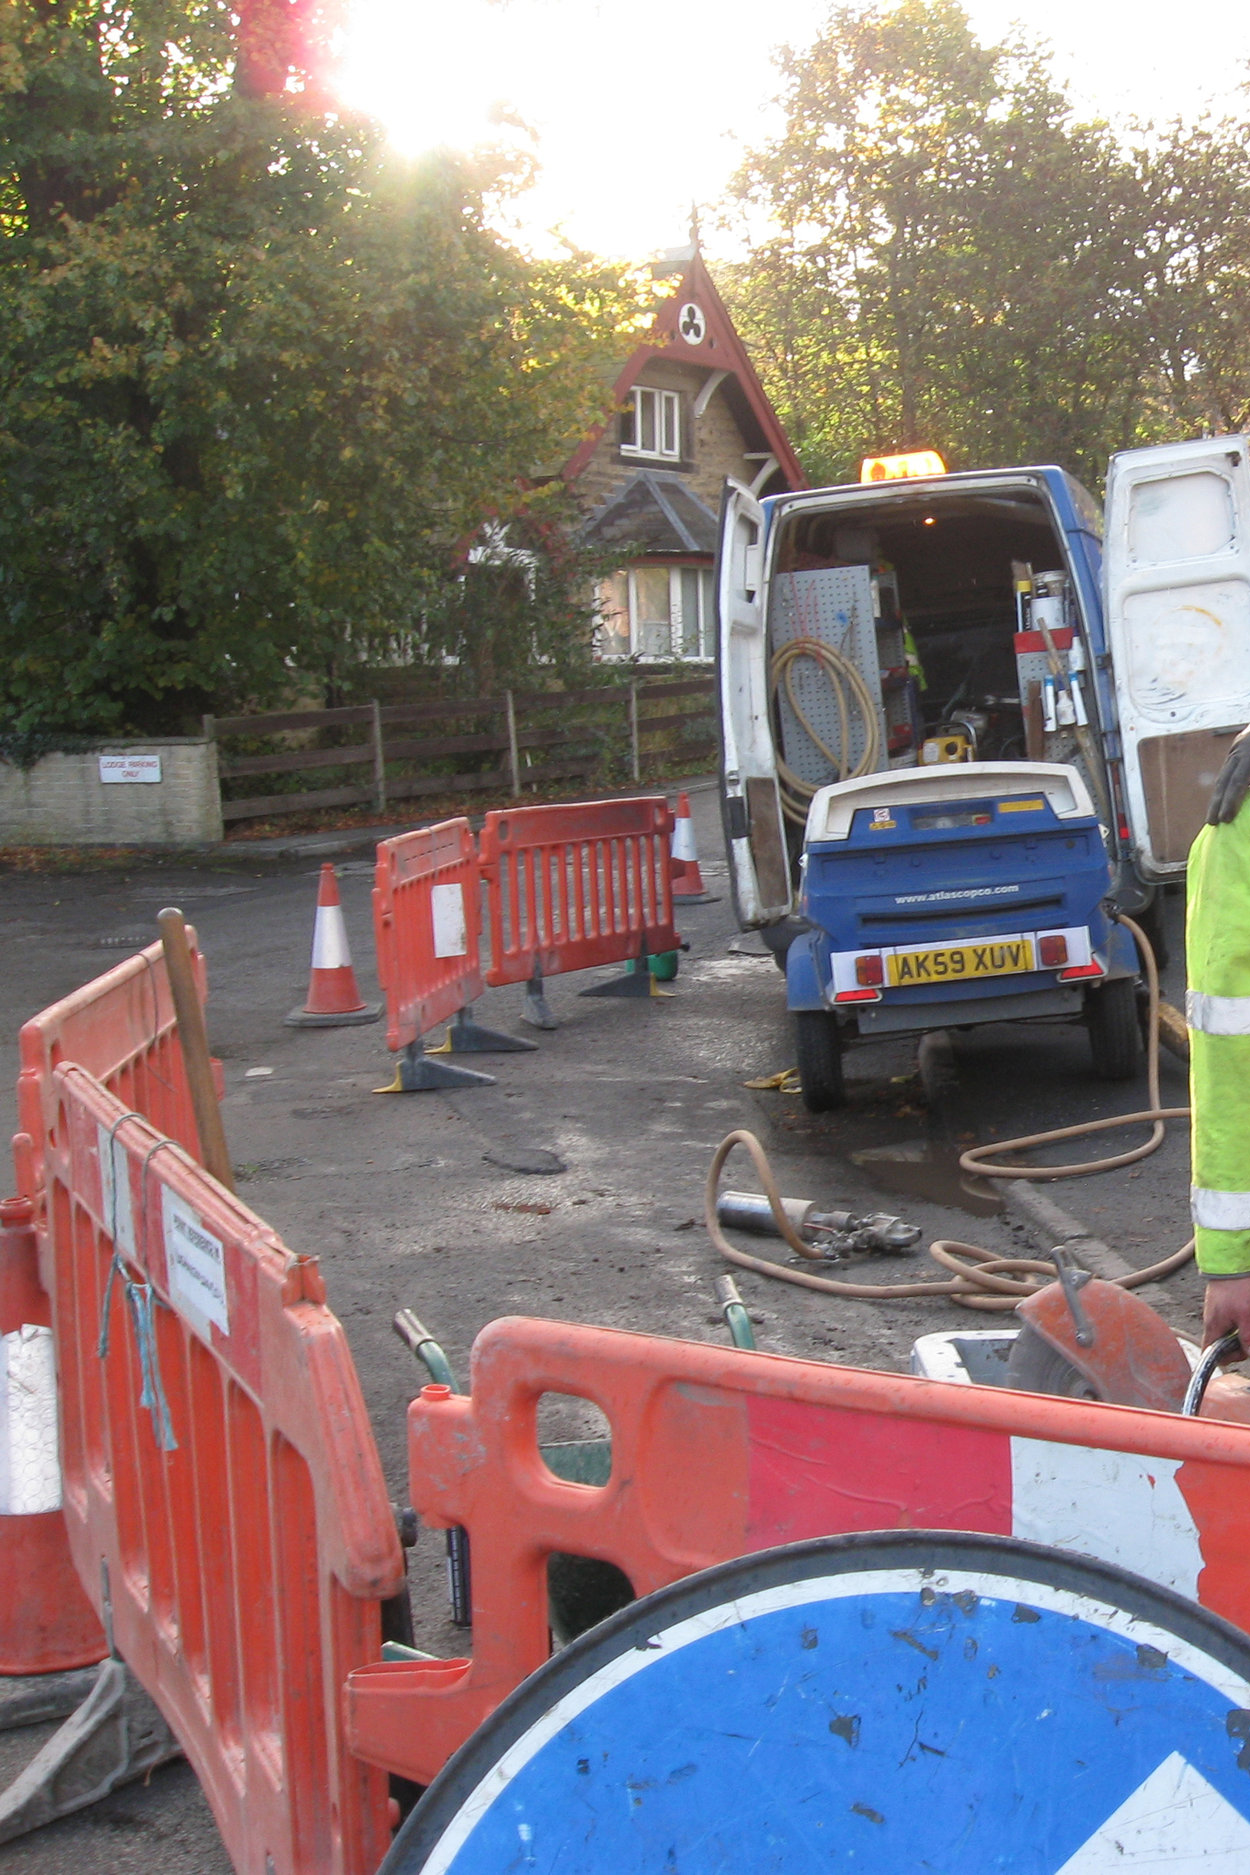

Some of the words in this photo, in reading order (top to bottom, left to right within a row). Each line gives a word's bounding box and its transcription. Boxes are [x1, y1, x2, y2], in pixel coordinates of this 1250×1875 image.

[894, 884, 1020, 905] www.atlascopco.com
[899, 951, 966, 980] AK59
[973, 943, 1024, 972] XUV
